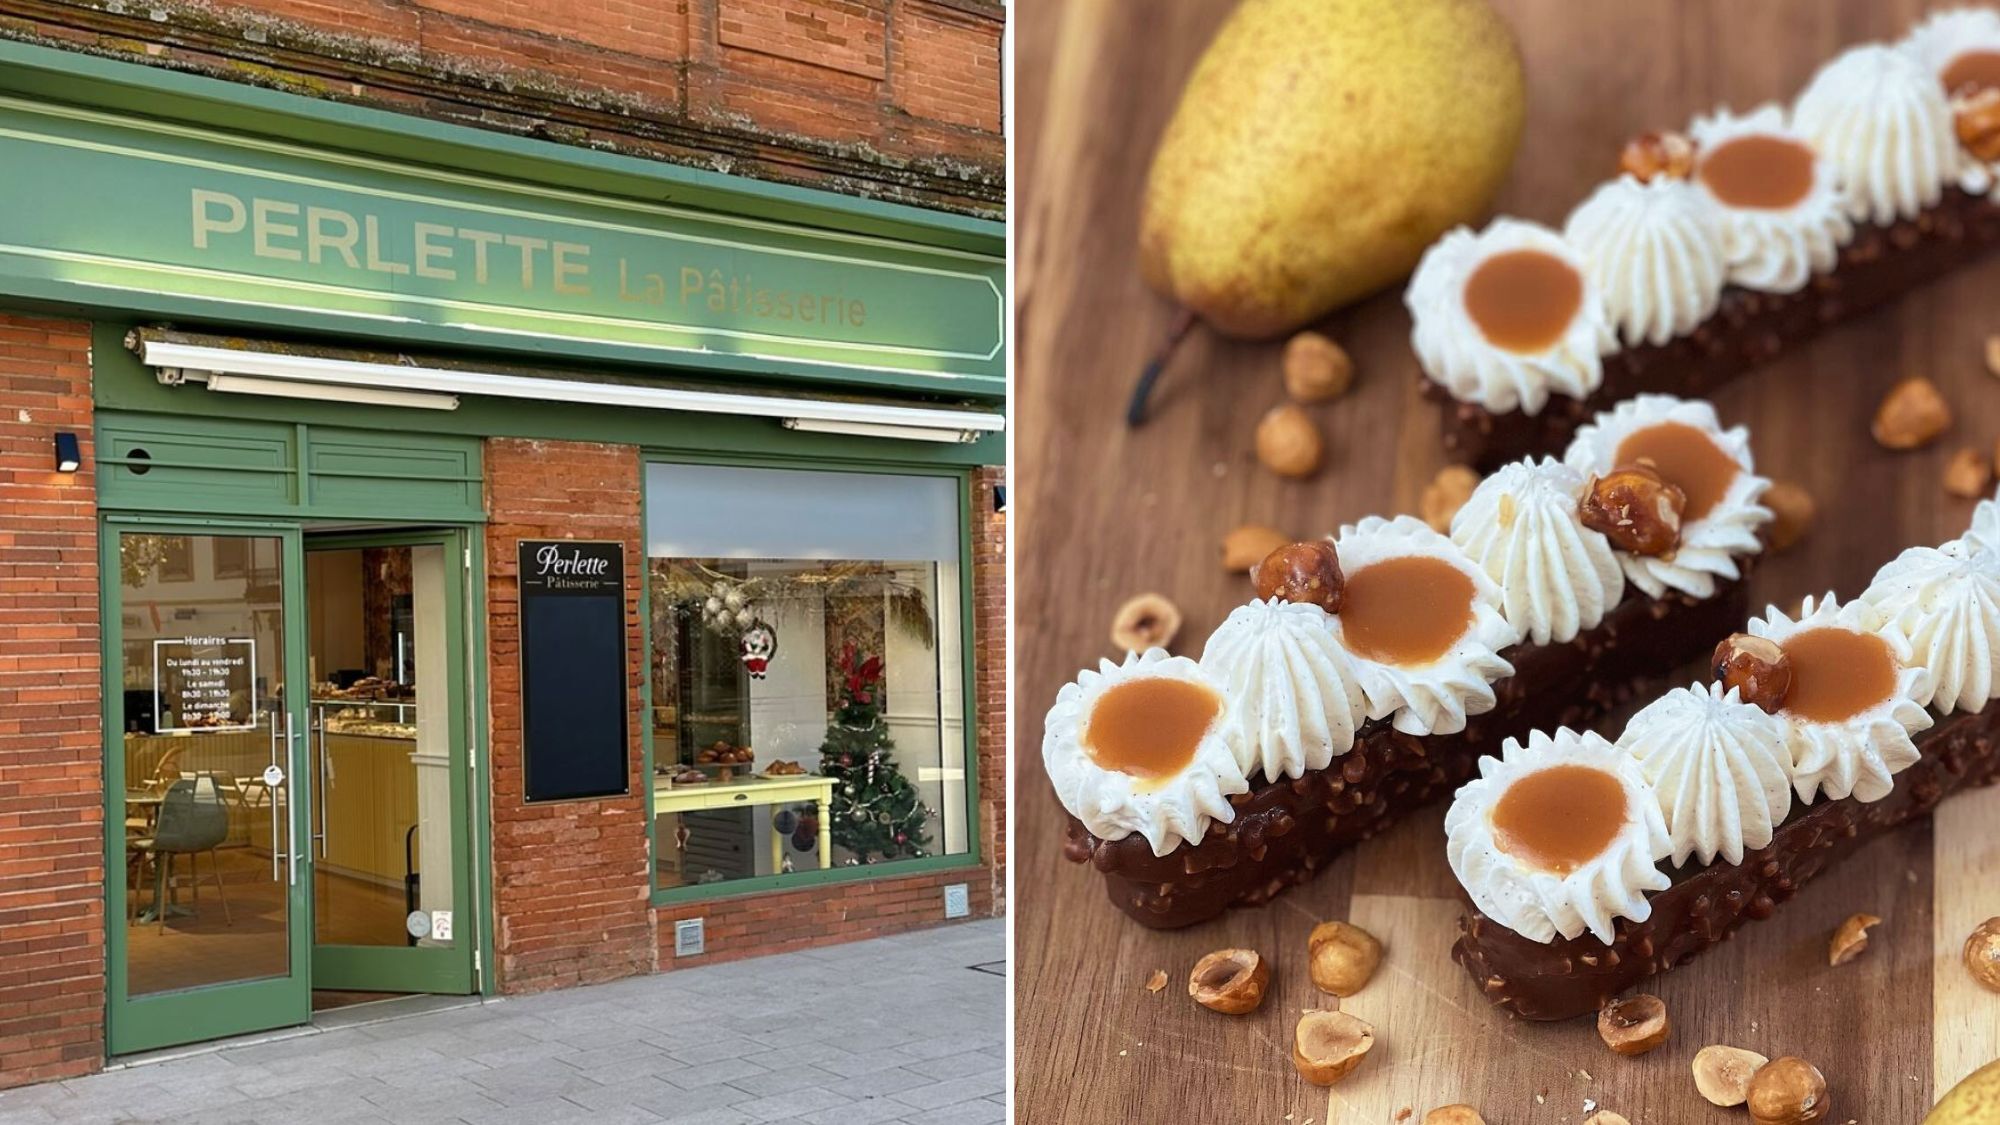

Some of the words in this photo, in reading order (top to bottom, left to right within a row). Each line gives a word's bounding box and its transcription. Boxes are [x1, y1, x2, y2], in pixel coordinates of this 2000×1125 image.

[191, 188, 591, 296] PERLETTE
[619, 258, 665, 305] La
[680, 266, 866, 327] Pâtisserie
[536, 544, 608, 575] Perlette
[547, 576, 599, 589] Pâtisserie
[184, 635, 226, 645] Horaires
[166, 658, 177, 667] Du
[179, 658, 199, 666] lundi
[212, 657, 244, 666] vendredi
[187, 680, 197, 688] Le
[199, 680, 225, 688] samedi
[182, 702, 193, 710] Le
[194, 702, 230, 710] dimanche
